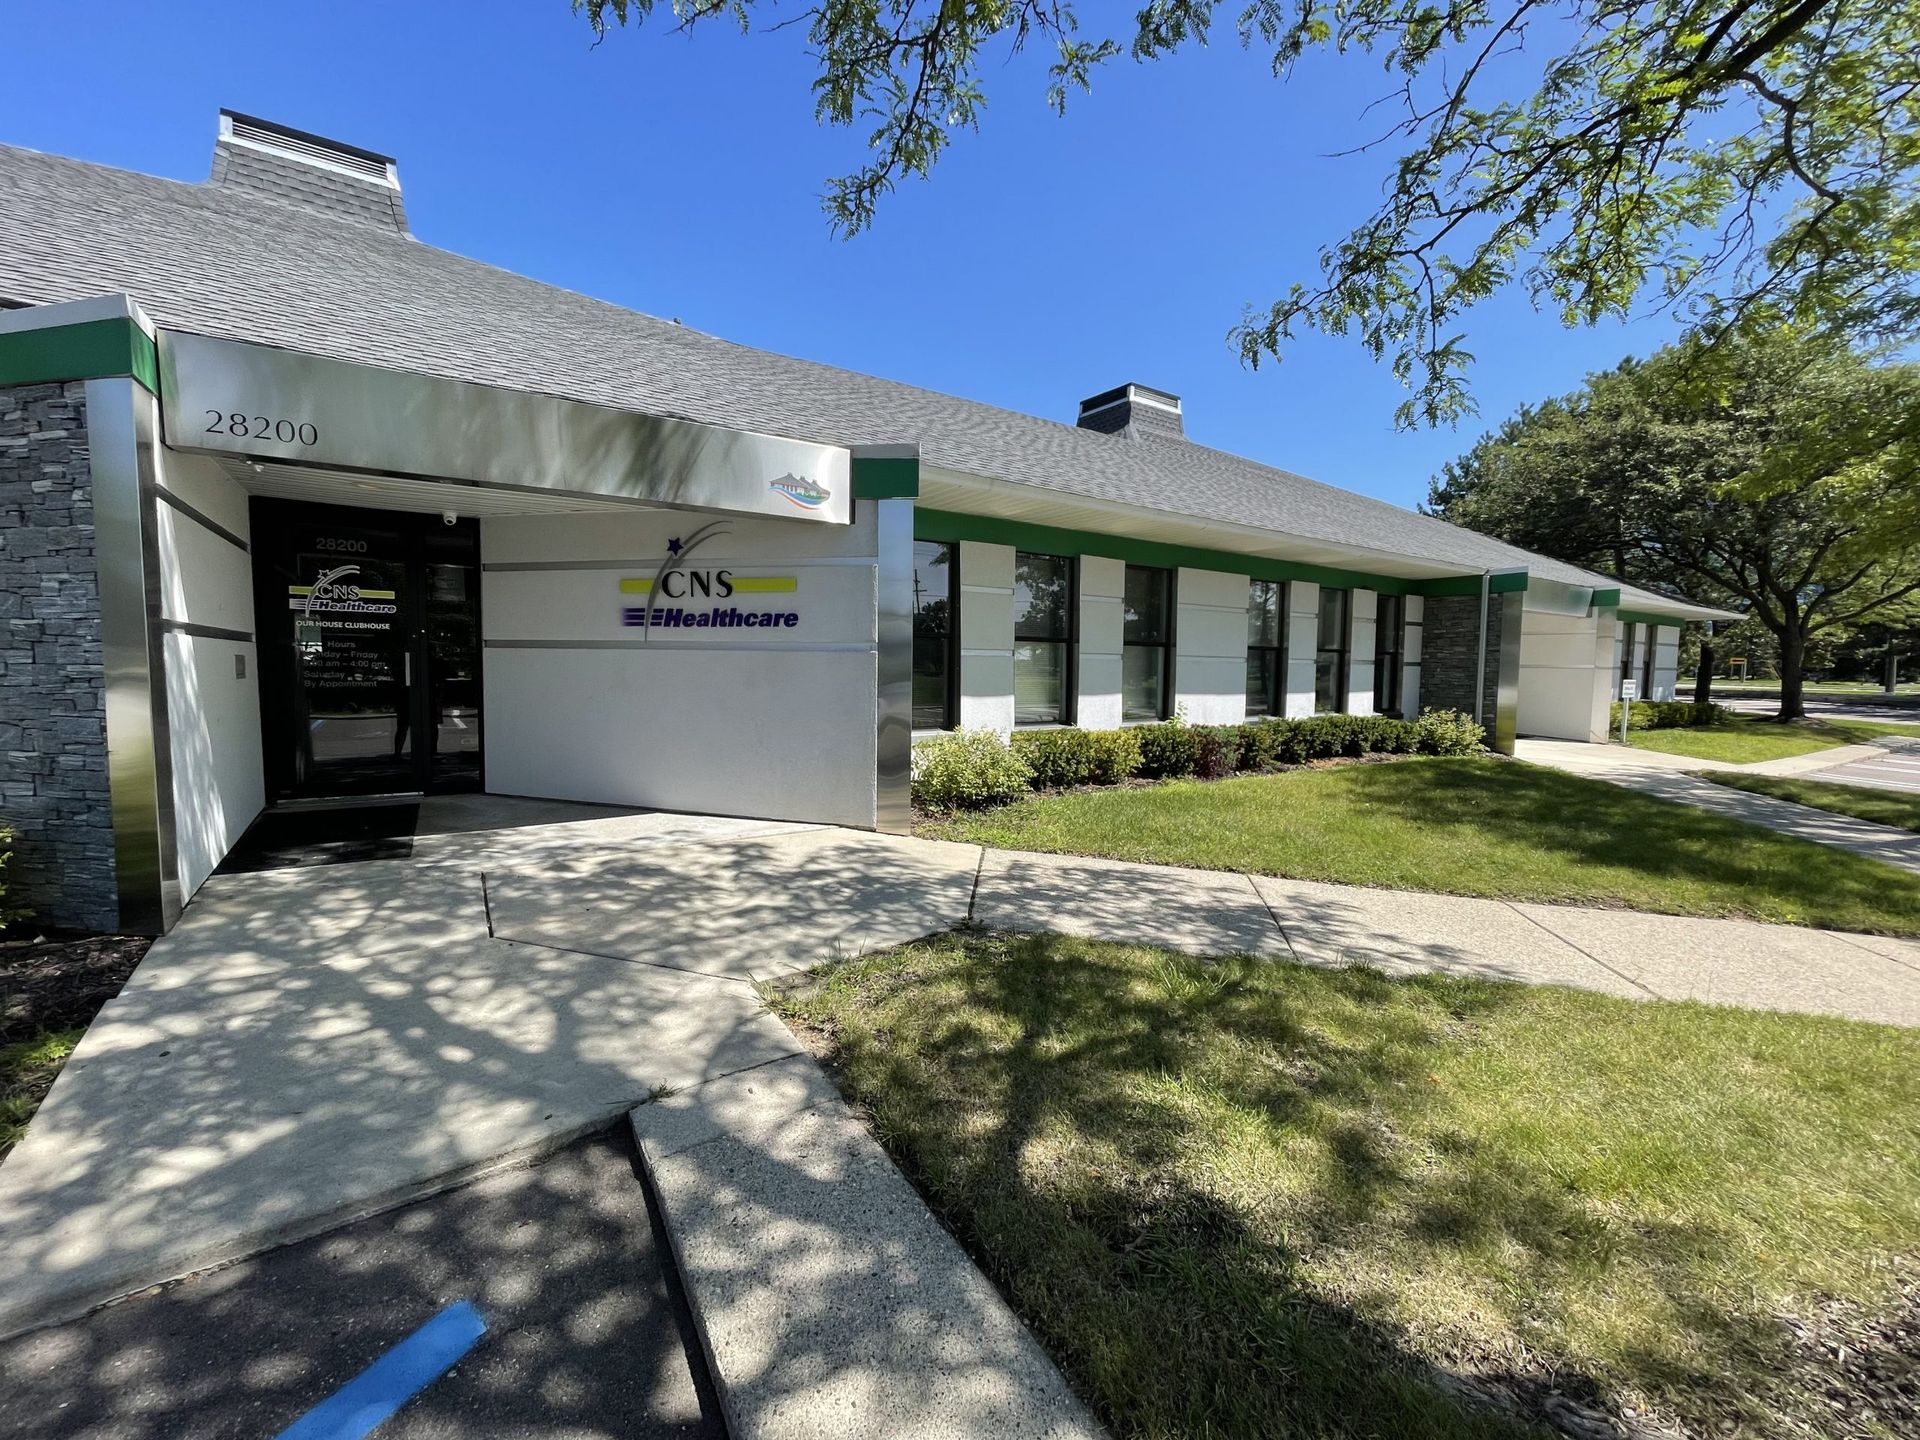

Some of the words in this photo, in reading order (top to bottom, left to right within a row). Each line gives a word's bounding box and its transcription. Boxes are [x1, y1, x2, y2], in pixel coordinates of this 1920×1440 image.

[205, 410, 318, 446] 28200
[315, 537, 368, 553] 28200
[317, 584, 360, 600] CNS
[661, 570, 733, 598] CNS
[317, 600, 397, 613] Healthcare
[663, 607, 799, 628] Healthcare
[344, 622, 391, 630] CLUBHOUSE
[350, 650, 378, 659] Friday
[304, 680, 316, 688] By
[319, 680, 377, 688] Appointment
